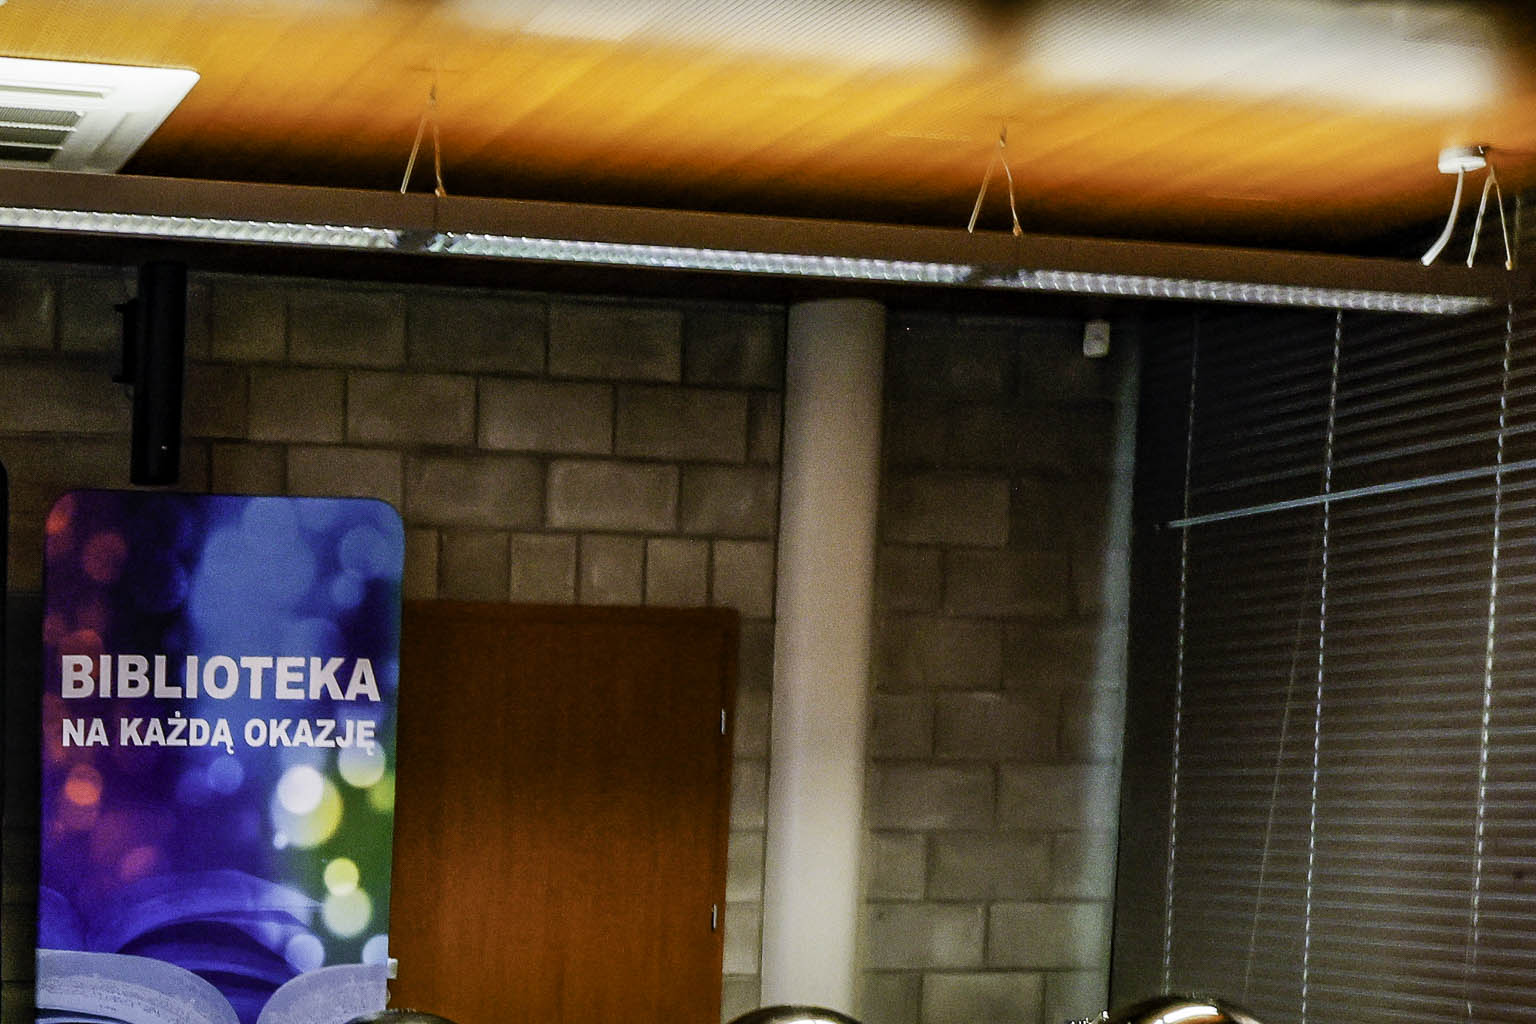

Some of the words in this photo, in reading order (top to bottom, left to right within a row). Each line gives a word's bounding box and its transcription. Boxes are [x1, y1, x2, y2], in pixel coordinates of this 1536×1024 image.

[61, 655, 381, 702] BIBLIOTEKA
[62, 719, 109, 747] NA
[120, 710, 234, 755] KAŻDĄ
[244, 719, 377, 755] OKAZJĘ
